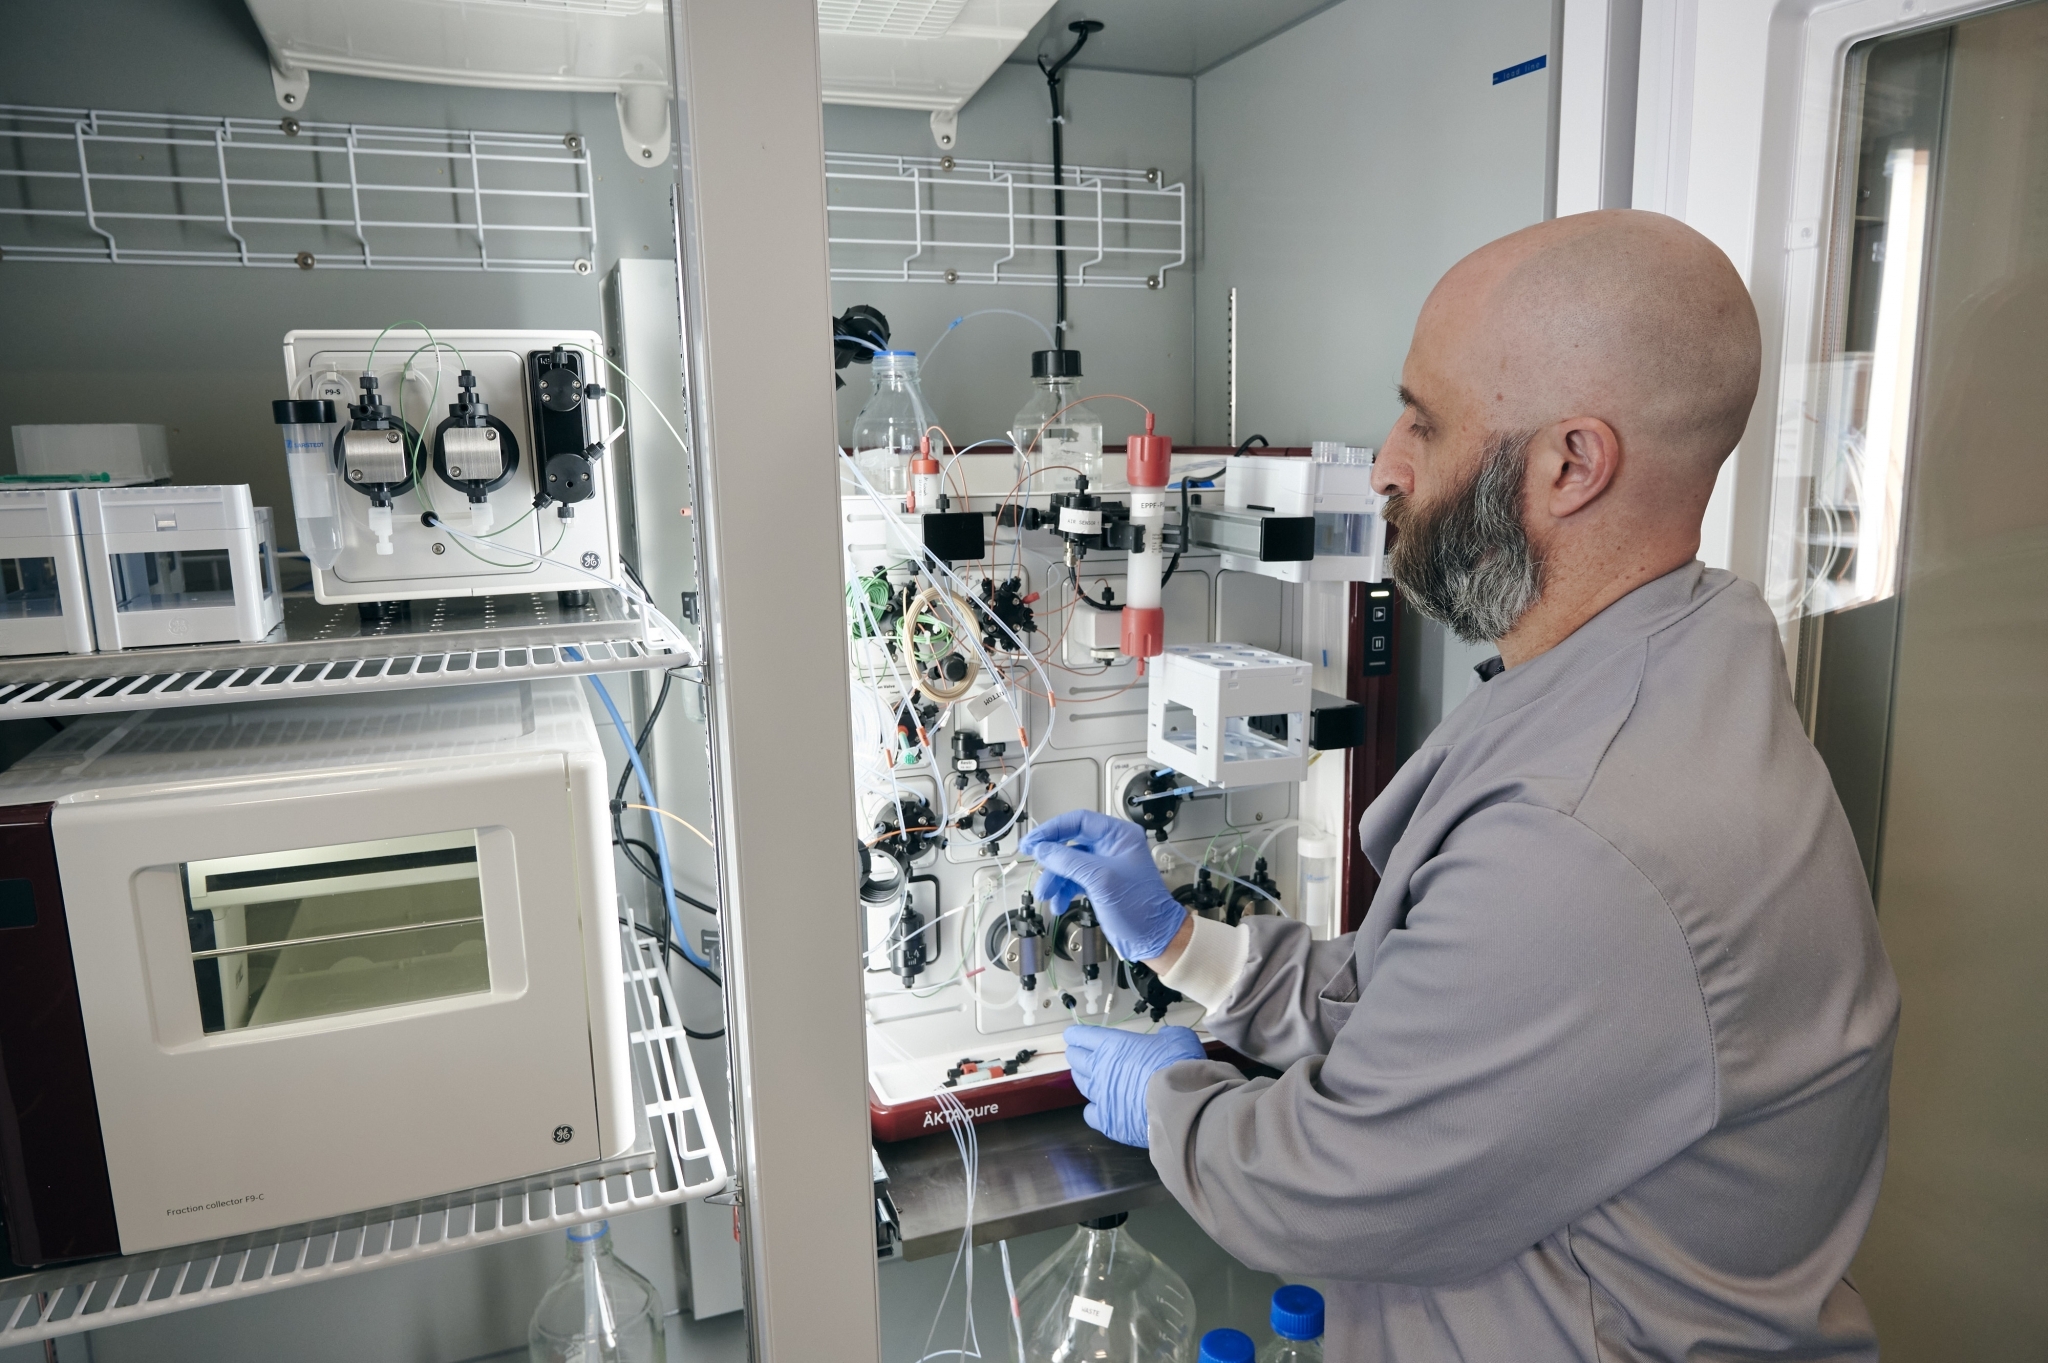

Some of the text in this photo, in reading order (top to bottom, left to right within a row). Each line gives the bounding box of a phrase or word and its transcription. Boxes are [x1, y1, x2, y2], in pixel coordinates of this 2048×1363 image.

[325, 388, 341, 396] P9-S
[983, 691, 1005, 706] OTTOM
[166, 1193, 265, 1216] Fraction collector F9-C
[1081, 1306, 1100, 1317] WASTE
